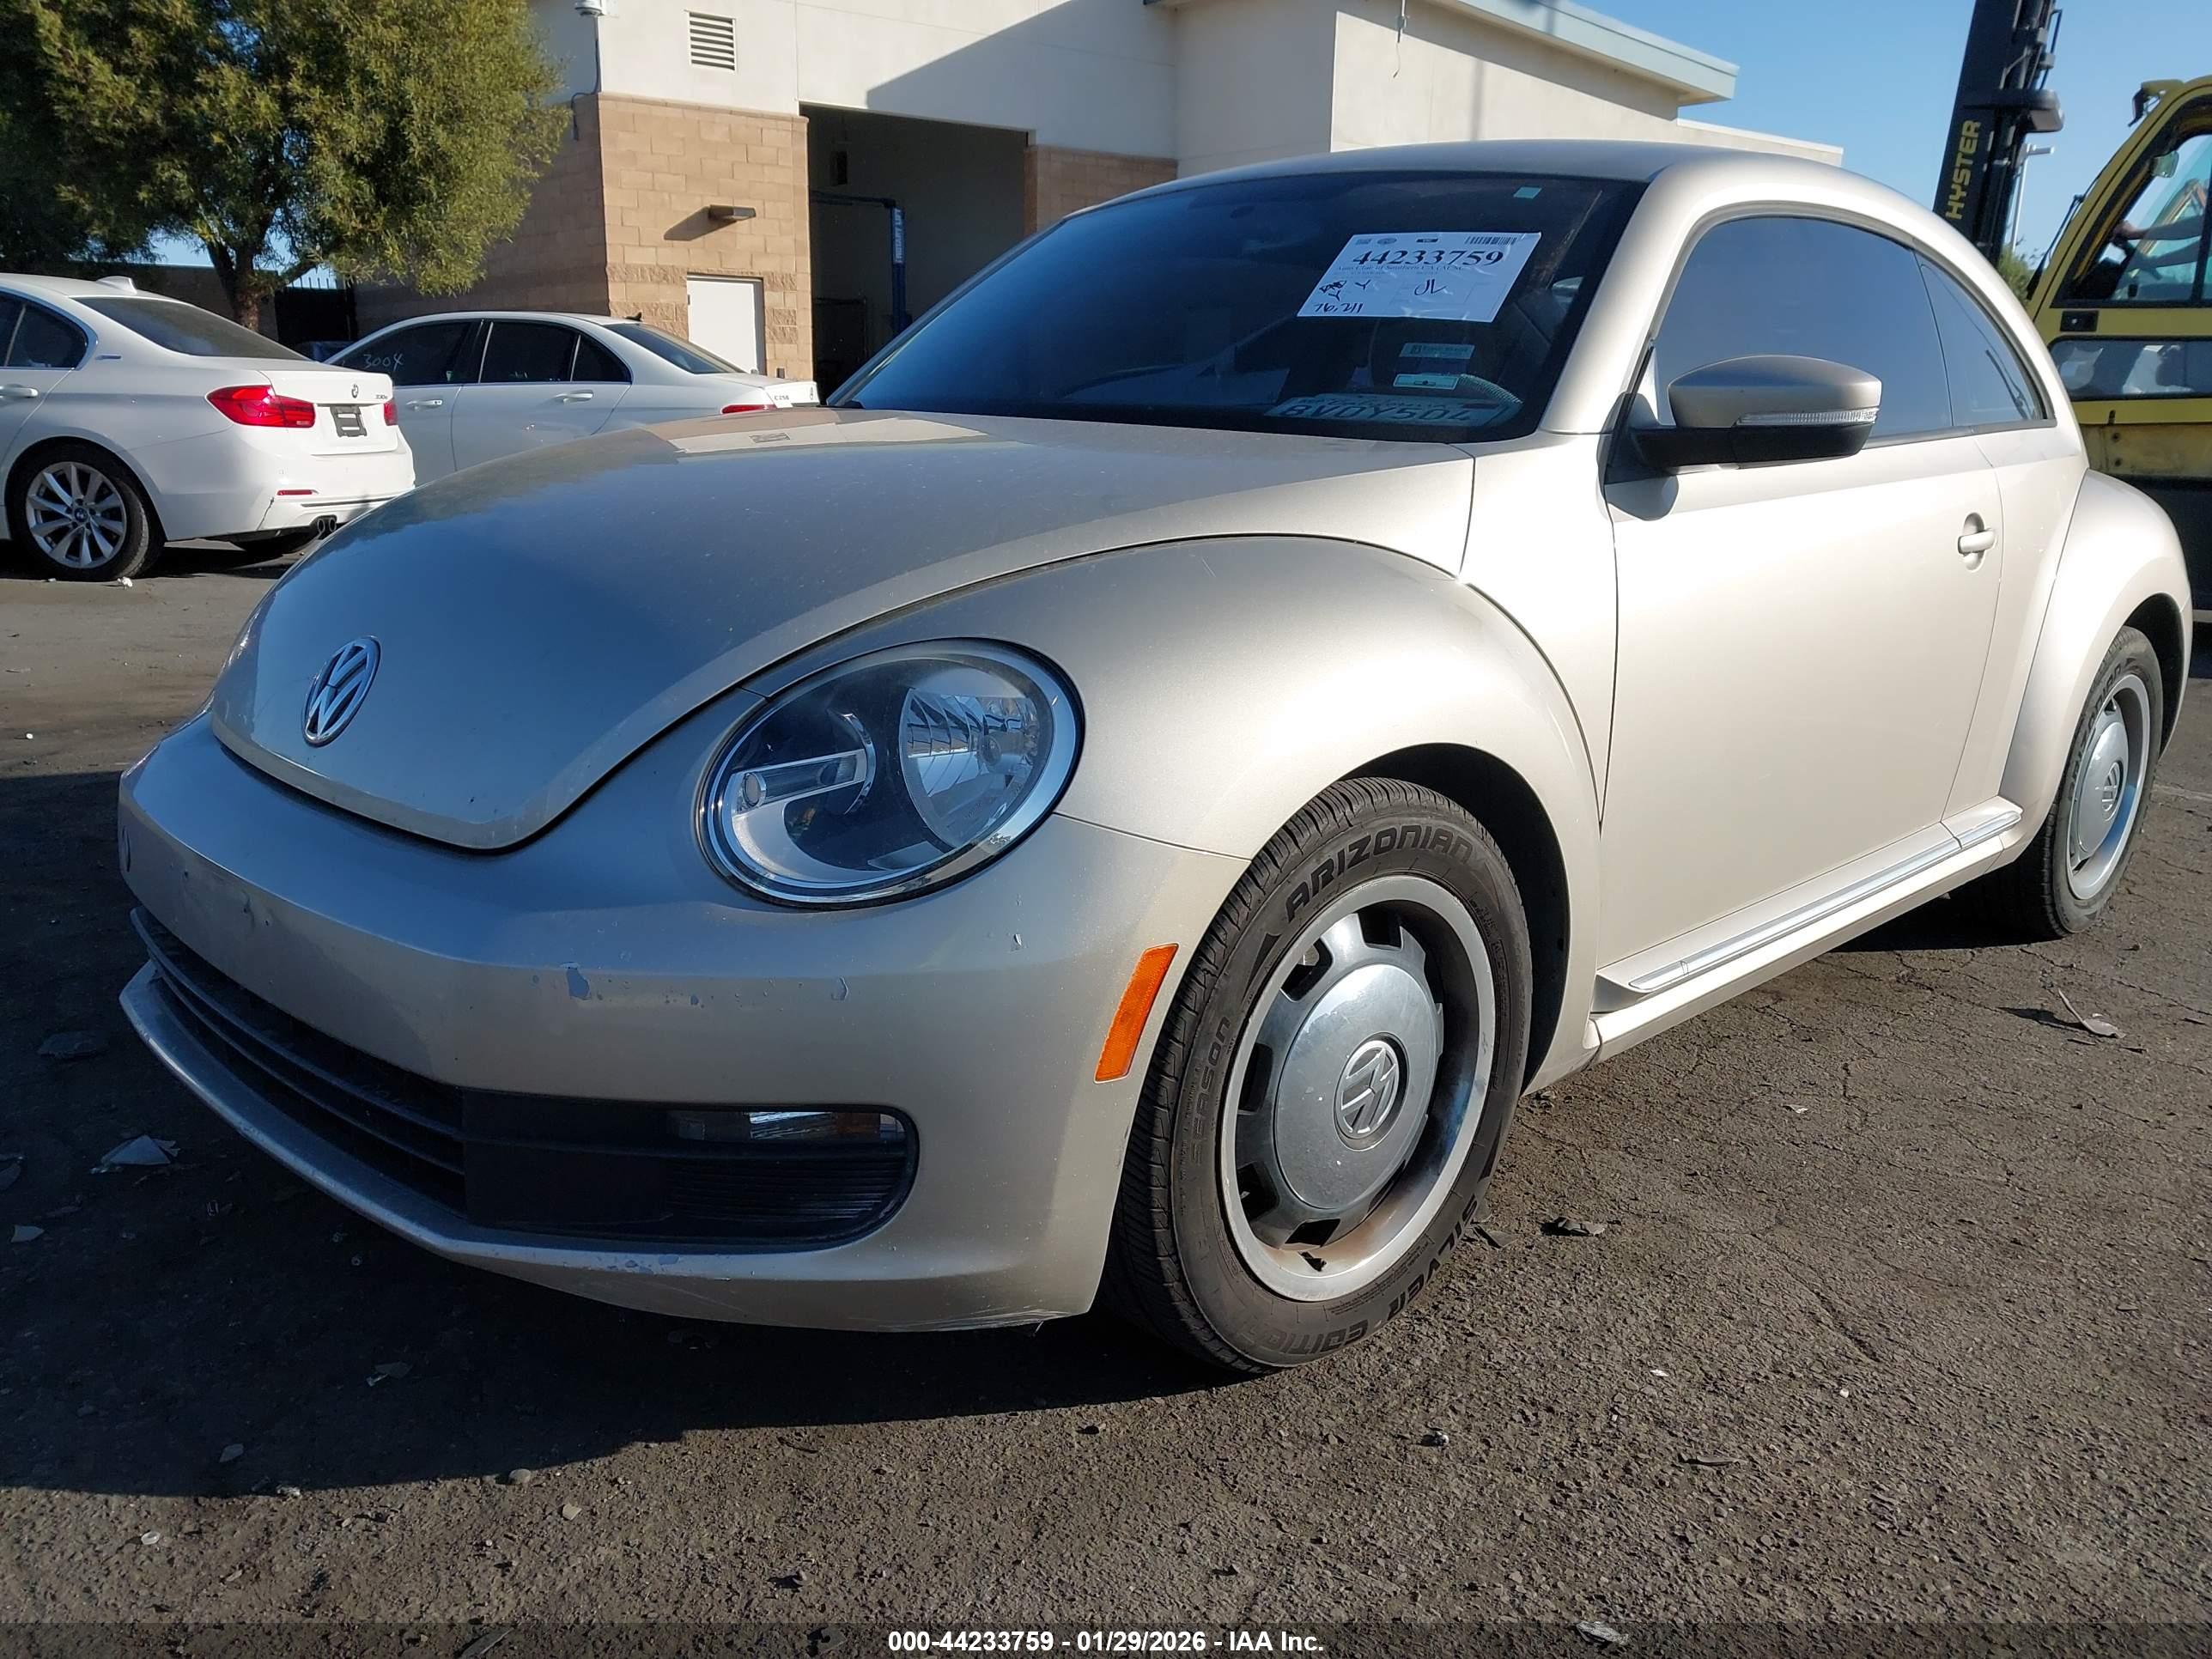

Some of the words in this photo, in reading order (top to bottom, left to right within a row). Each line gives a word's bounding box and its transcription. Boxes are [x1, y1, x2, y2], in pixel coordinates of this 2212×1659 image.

[1945, 120, 1981, 220] HYSTER
[1353, 250, 1504, 265] 44233759
[1285, 824, 1474, 924] ARIZONIAN
[1387, 1193, 1478, 1322] SILVER
